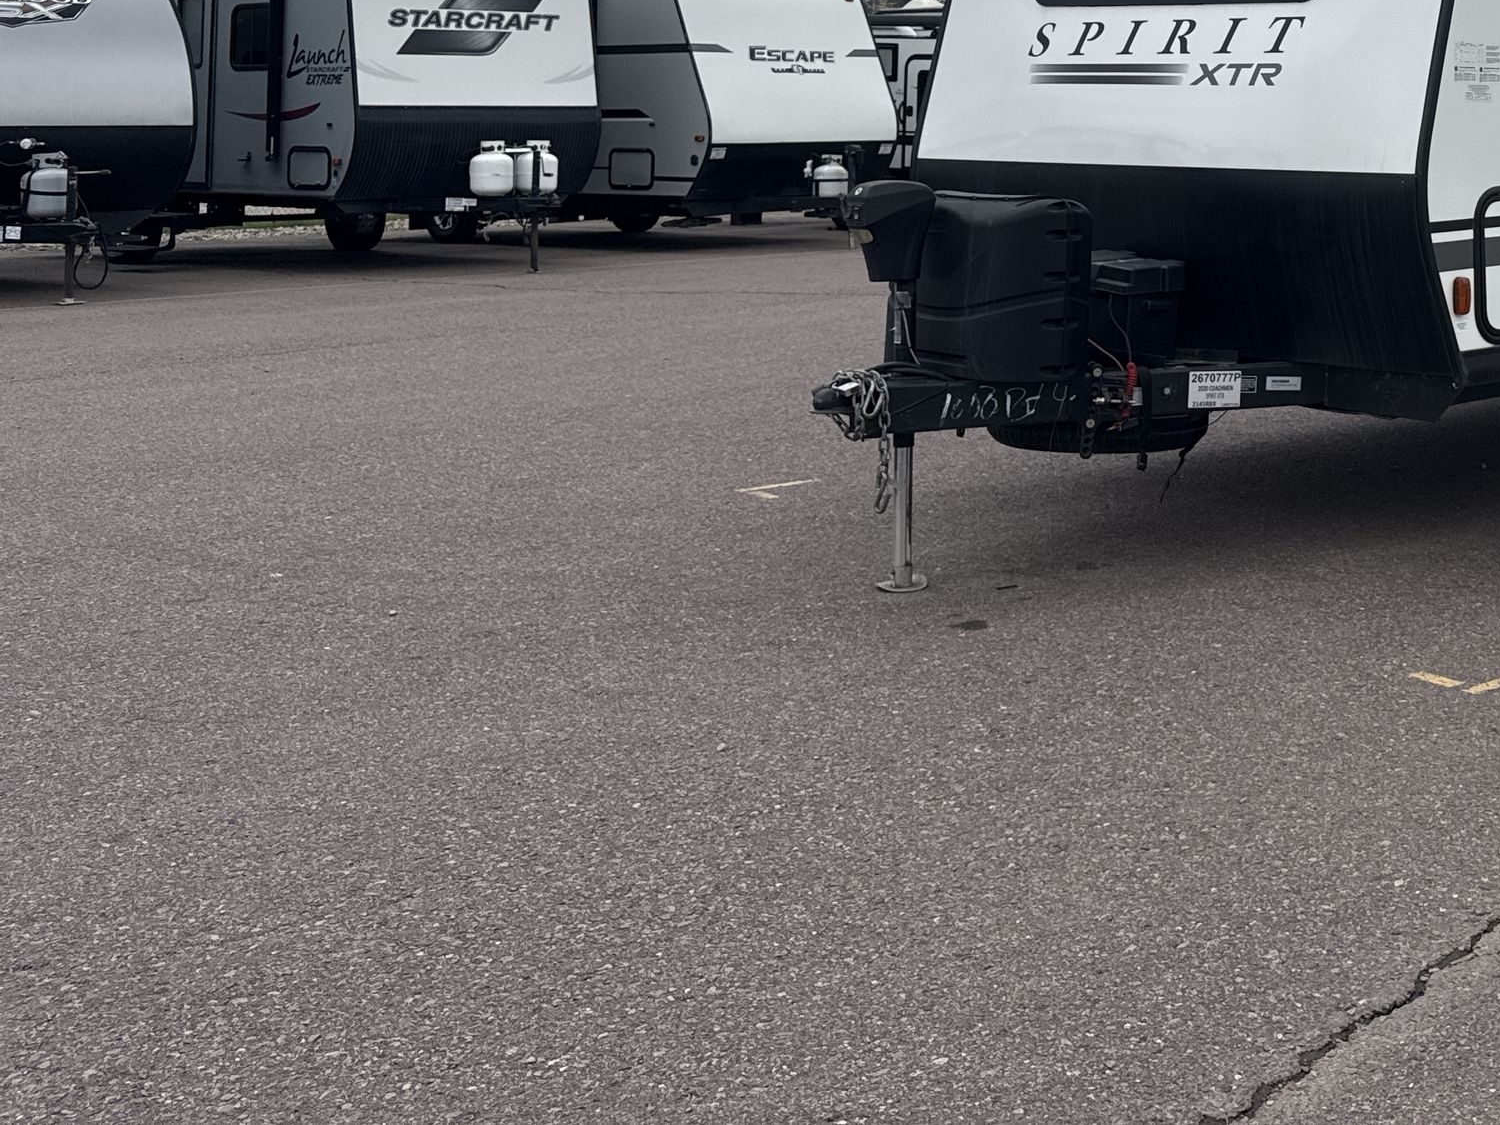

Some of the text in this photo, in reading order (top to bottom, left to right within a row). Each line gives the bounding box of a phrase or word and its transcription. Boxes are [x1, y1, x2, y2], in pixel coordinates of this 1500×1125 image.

[388, 8, 560, 32] STARCRAFT
[1028, 16, 1306, 57] SPIRIT
[286, 29, 347, 79] Launch
[305, 74, 344, 86] EXTREME
[1190, 63, 1282, 86] XTR
[1191, 372, 1241, 383] 2670777P
